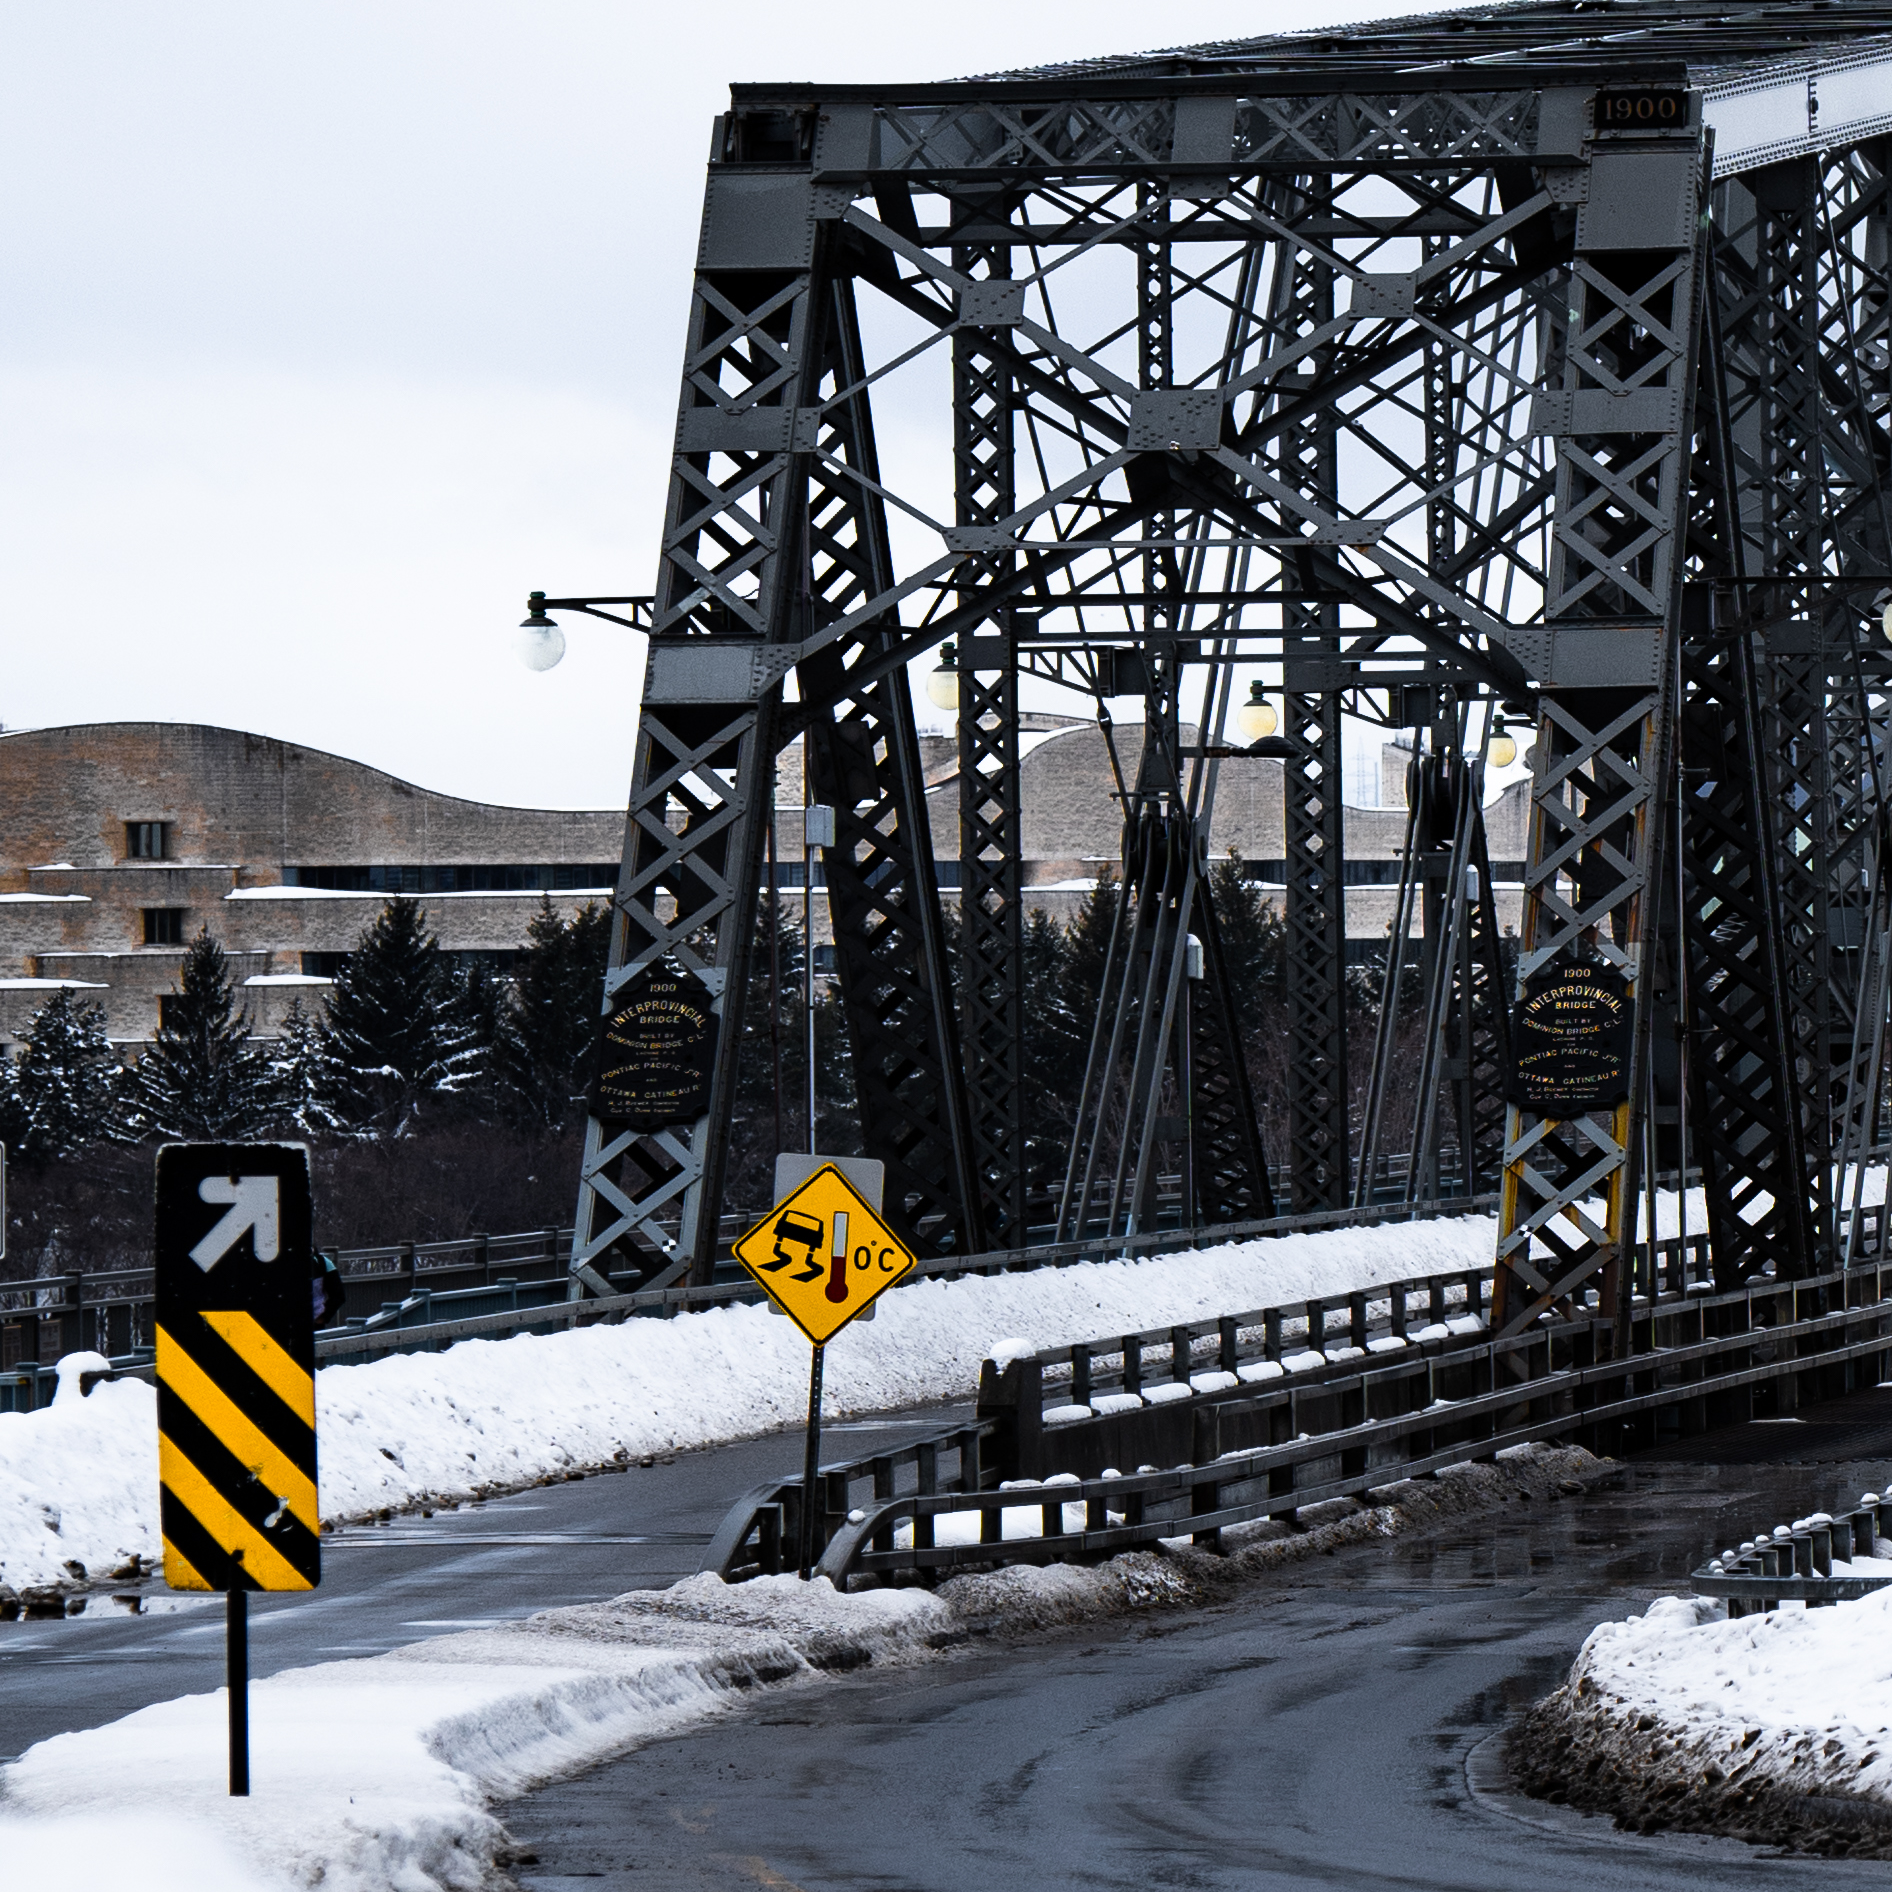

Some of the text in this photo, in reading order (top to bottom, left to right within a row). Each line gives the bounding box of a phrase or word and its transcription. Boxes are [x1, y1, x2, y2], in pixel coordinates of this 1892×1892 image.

[1605, 96, 1677, 120] 1900
[1564, 968, 1591, 978] 1900
[650, 983, 677, 992] 1900
[1525, 985, 1622, 1014] INTERPROVINCIAL
[1555, 1000, 1596, 1009] BRIDGE
[610, 1000, 706, 1028] INTERPROVINCIAL
[640, 1015, 680, 1024] BRIDGE
[1522, 1017, 1564, 1035] DOMINION
[1566, 1024, 1601, 1036] BRIDGE
[606, 1031, 648, 1049] DOMINION
[650, 1039, 684, 1049] BRIDGE
[1518, 1049, 1558, 1067] PONTIAC
[1561, 1048, 1599, 1057] PACIFIC
[601, 1063, 640, 1080] PONTIAC
[643, 1062, 681, 1071] PACIFIC
[1518, 1071, 1554, 1084] OTTAWA
[1562, 1072, 1609, 1085] GATINEAU
[600, 1085, 636, 1098] OTTAWA
[644, 1087, 690, 1099] GATINEAU
[853, 1240, 896, 1272] 0°C
